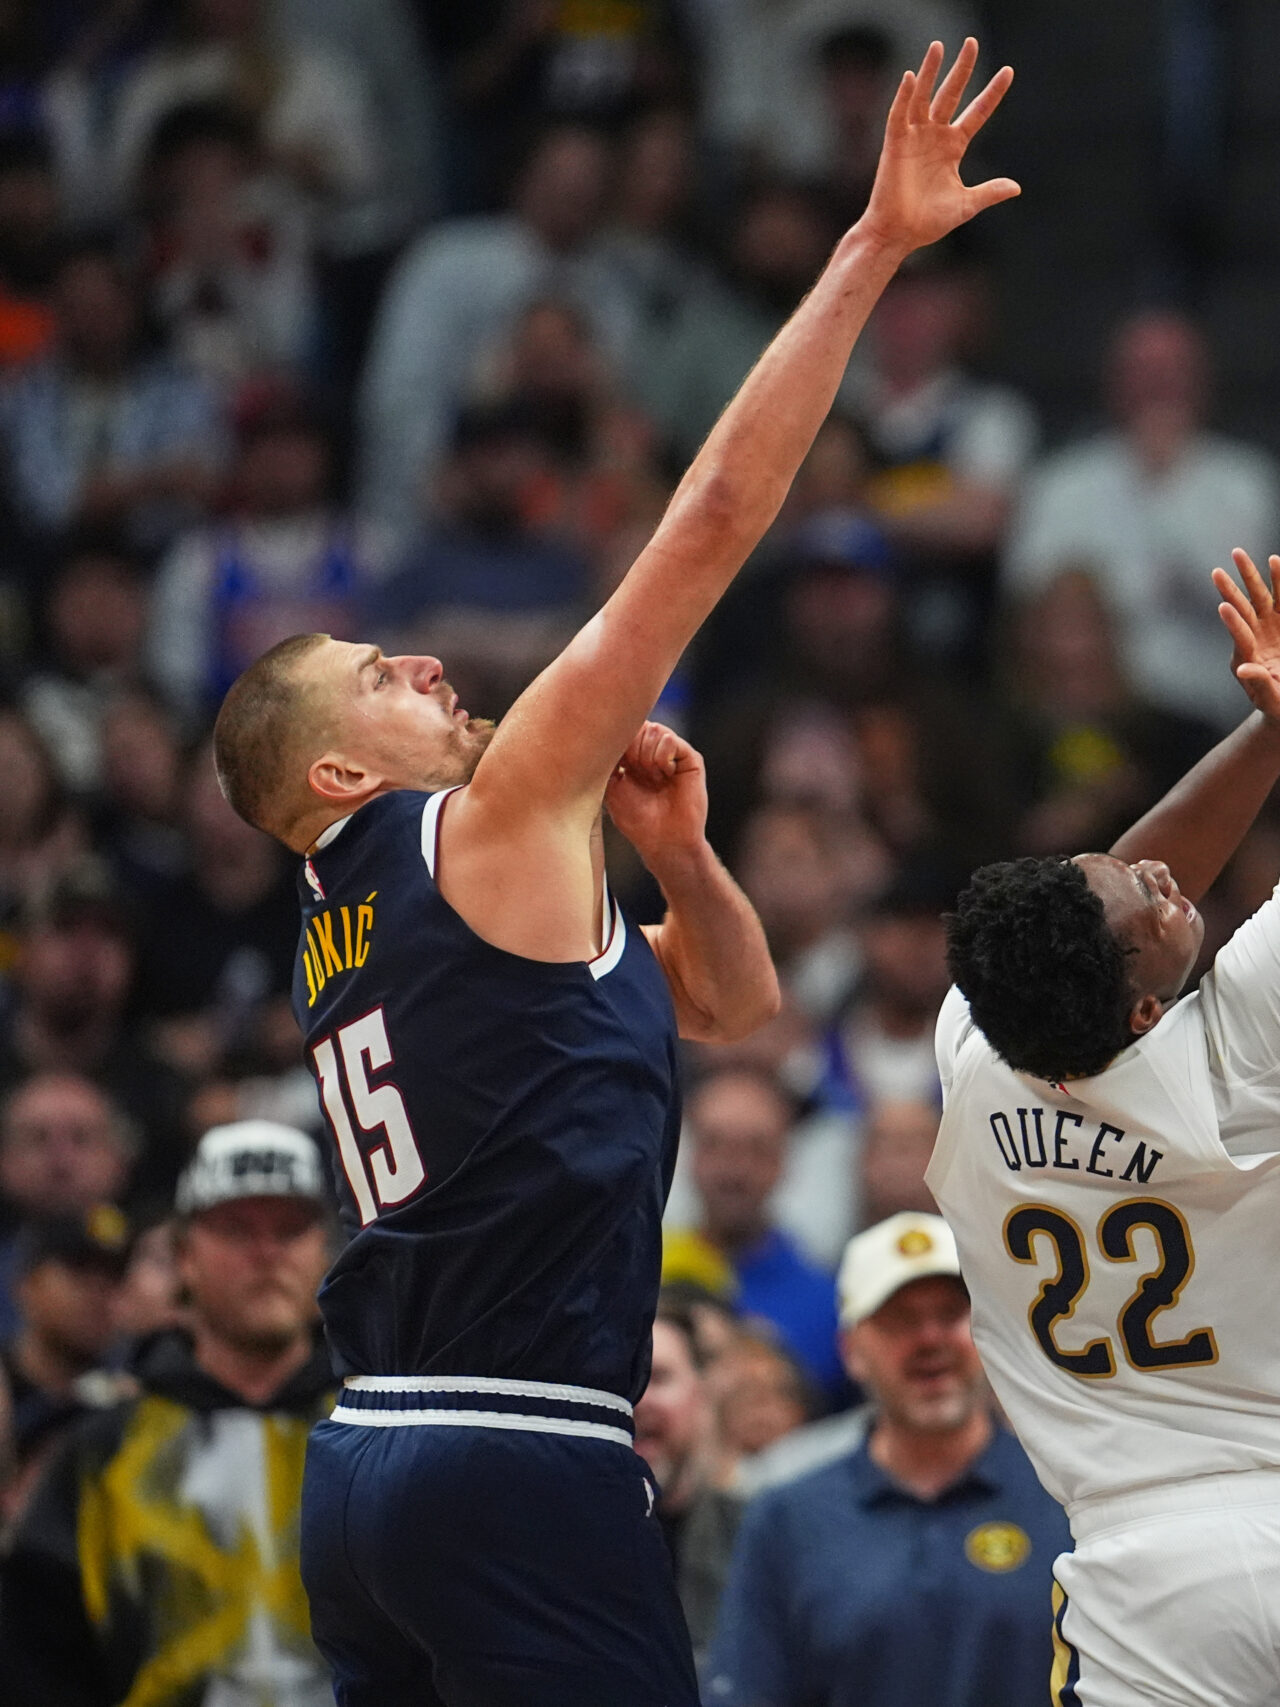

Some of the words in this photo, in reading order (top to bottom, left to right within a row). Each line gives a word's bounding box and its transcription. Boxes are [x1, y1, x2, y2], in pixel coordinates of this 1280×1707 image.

[303, 891, 378, 1008] JOKIĆ
[311, 1003, 428, 1230] 15
[990, 1108, 1163, 1184] QUEEN
[1002, 1196, 1219, 1378] 22
